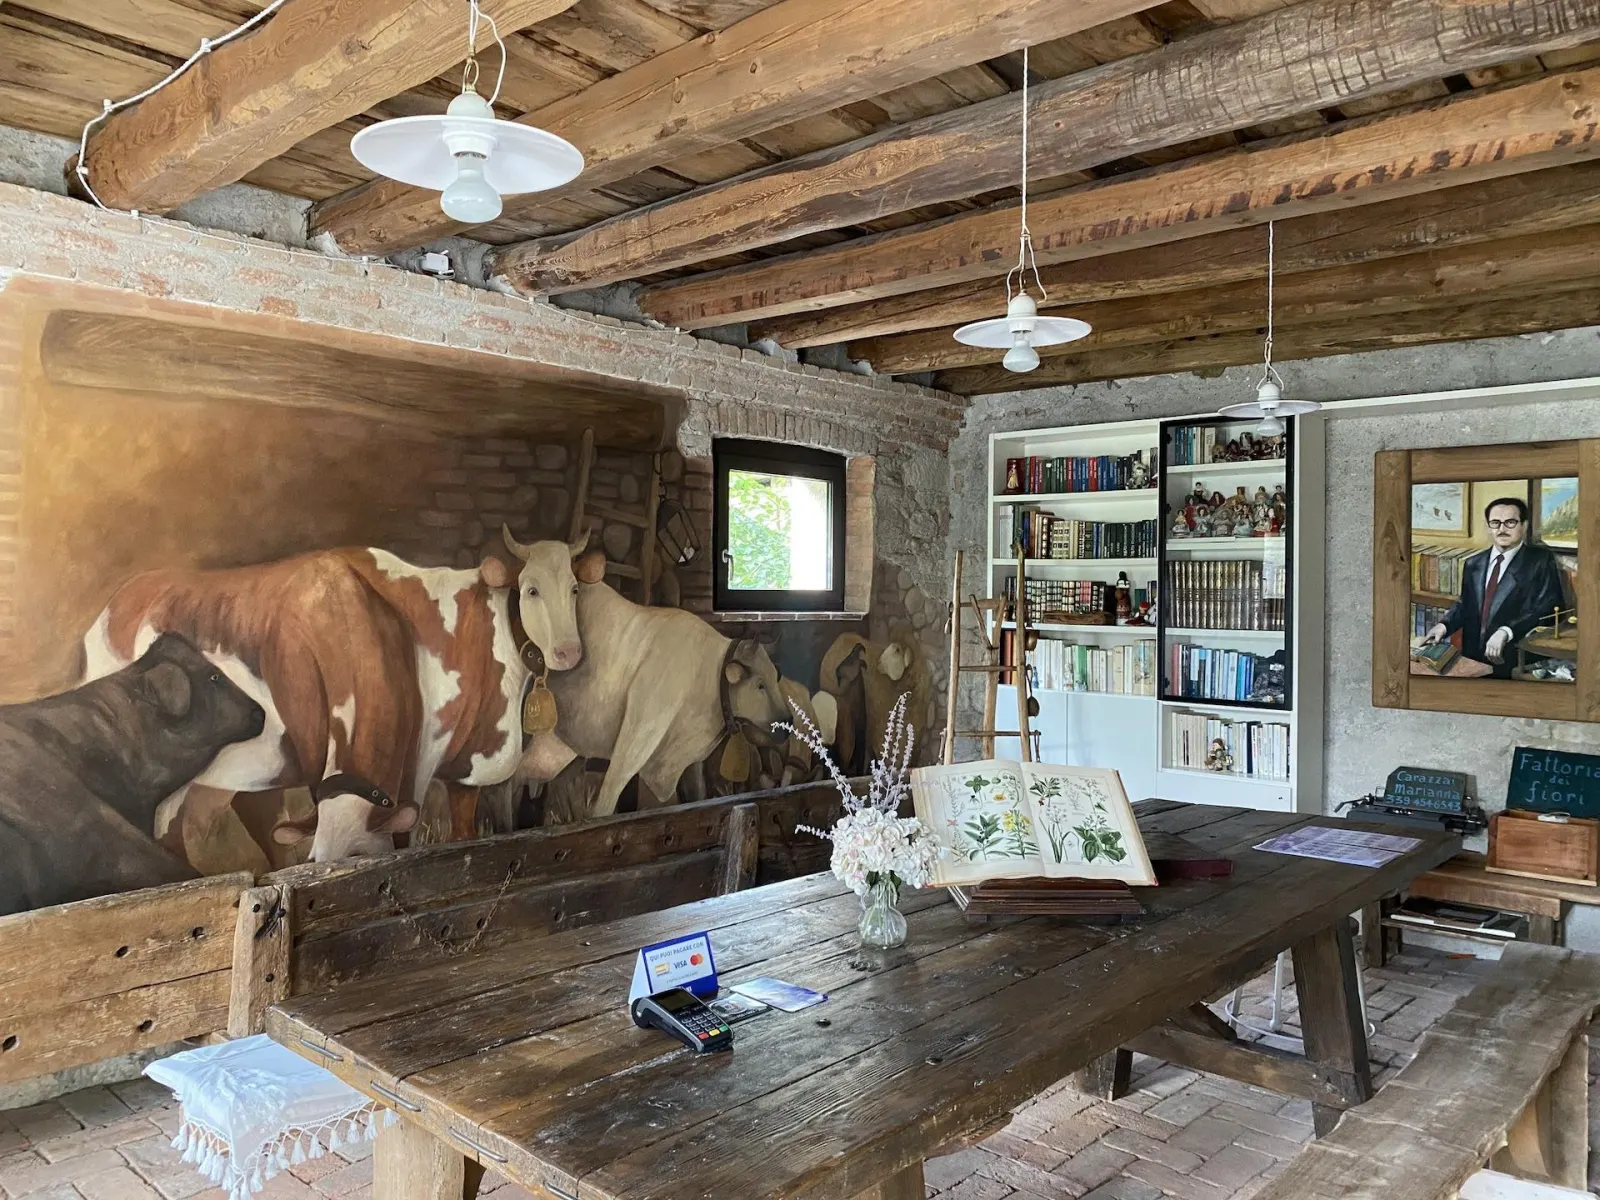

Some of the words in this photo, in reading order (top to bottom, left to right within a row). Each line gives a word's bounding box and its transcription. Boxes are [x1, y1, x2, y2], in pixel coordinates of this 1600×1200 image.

[1520, 753, 1600, 778] Fattoria
[1549, 775, 1570, 785] dei
[1394, 783, 1460, 799] Marianna
[1524, 780, 1584, 805] fiori
[693, 941, 704, 949] CON
[673, 959, 688, 969] VISA
